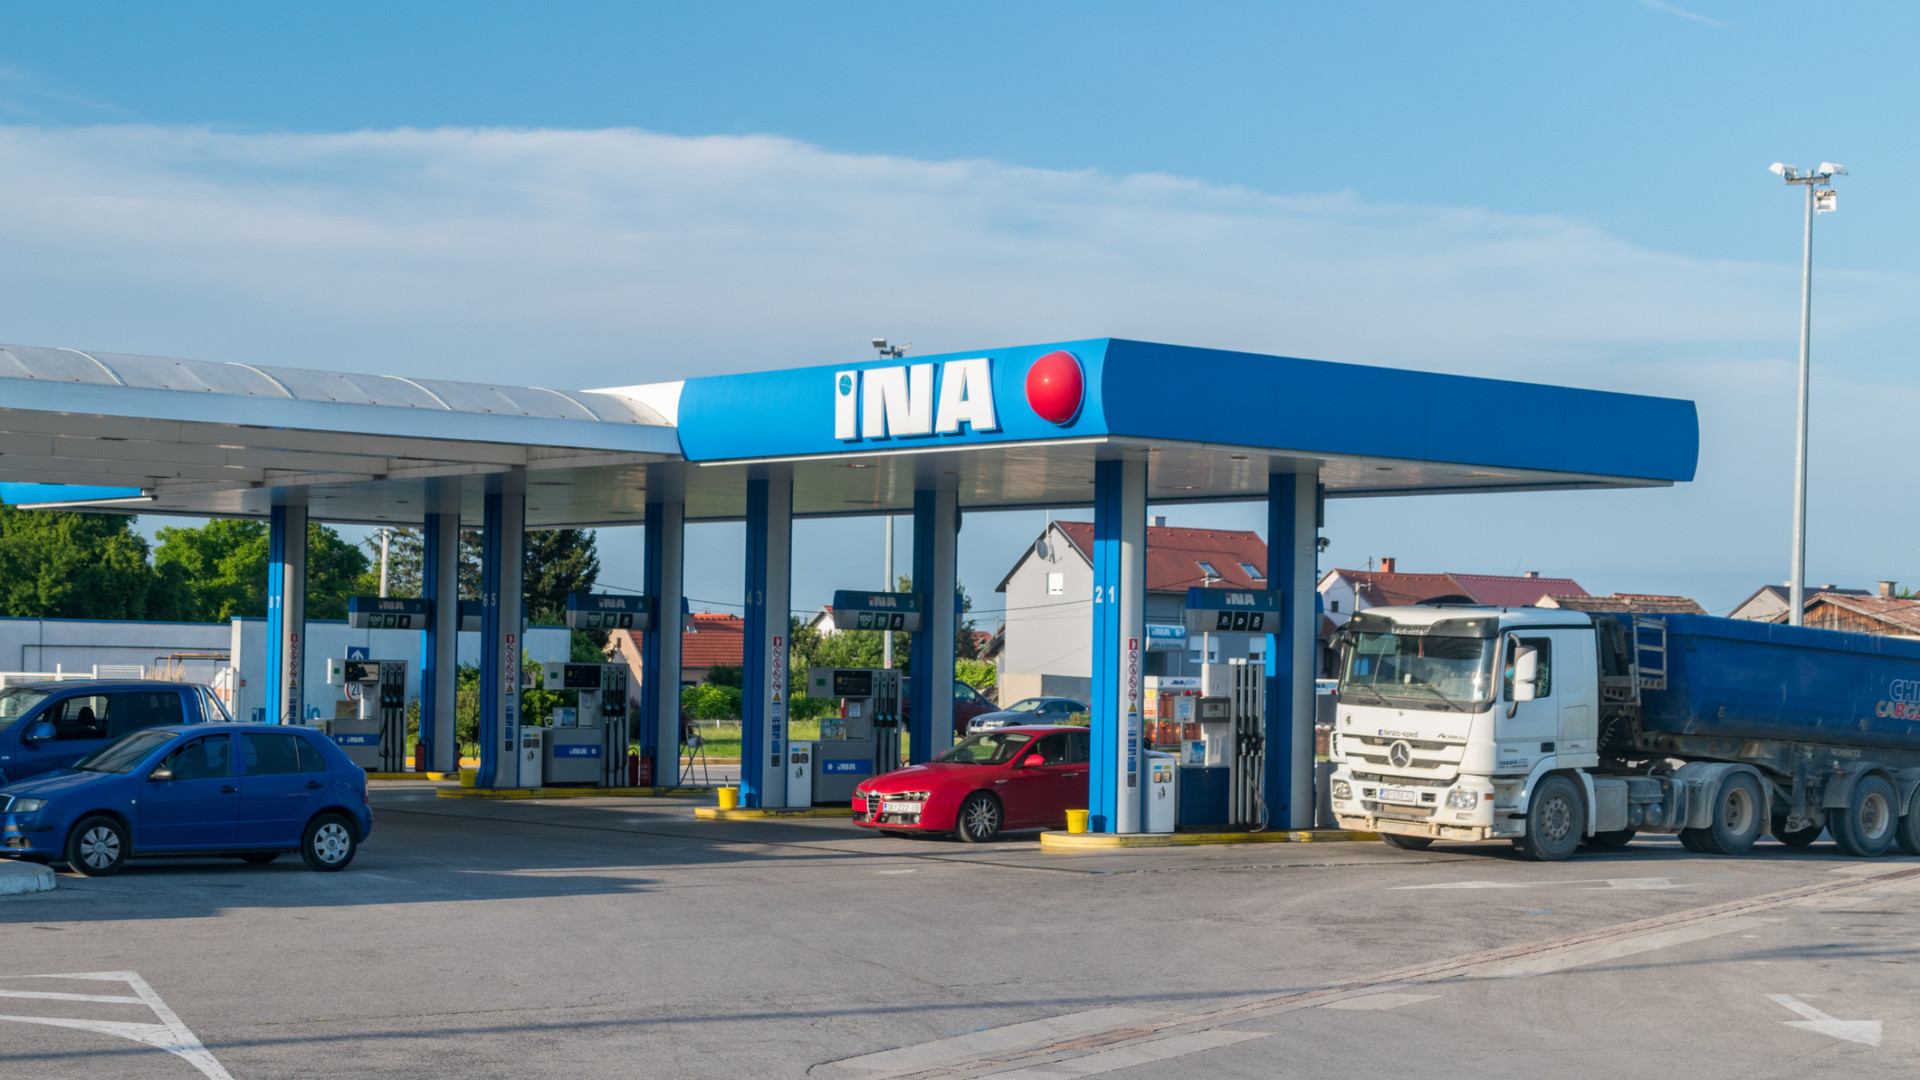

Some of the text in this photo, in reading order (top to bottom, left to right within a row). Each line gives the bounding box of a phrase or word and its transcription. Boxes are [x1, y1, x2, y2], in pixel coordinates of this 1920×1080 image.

[276, 596, 281, 609] 7
[1095, 586, 1115, 604] 2 1
